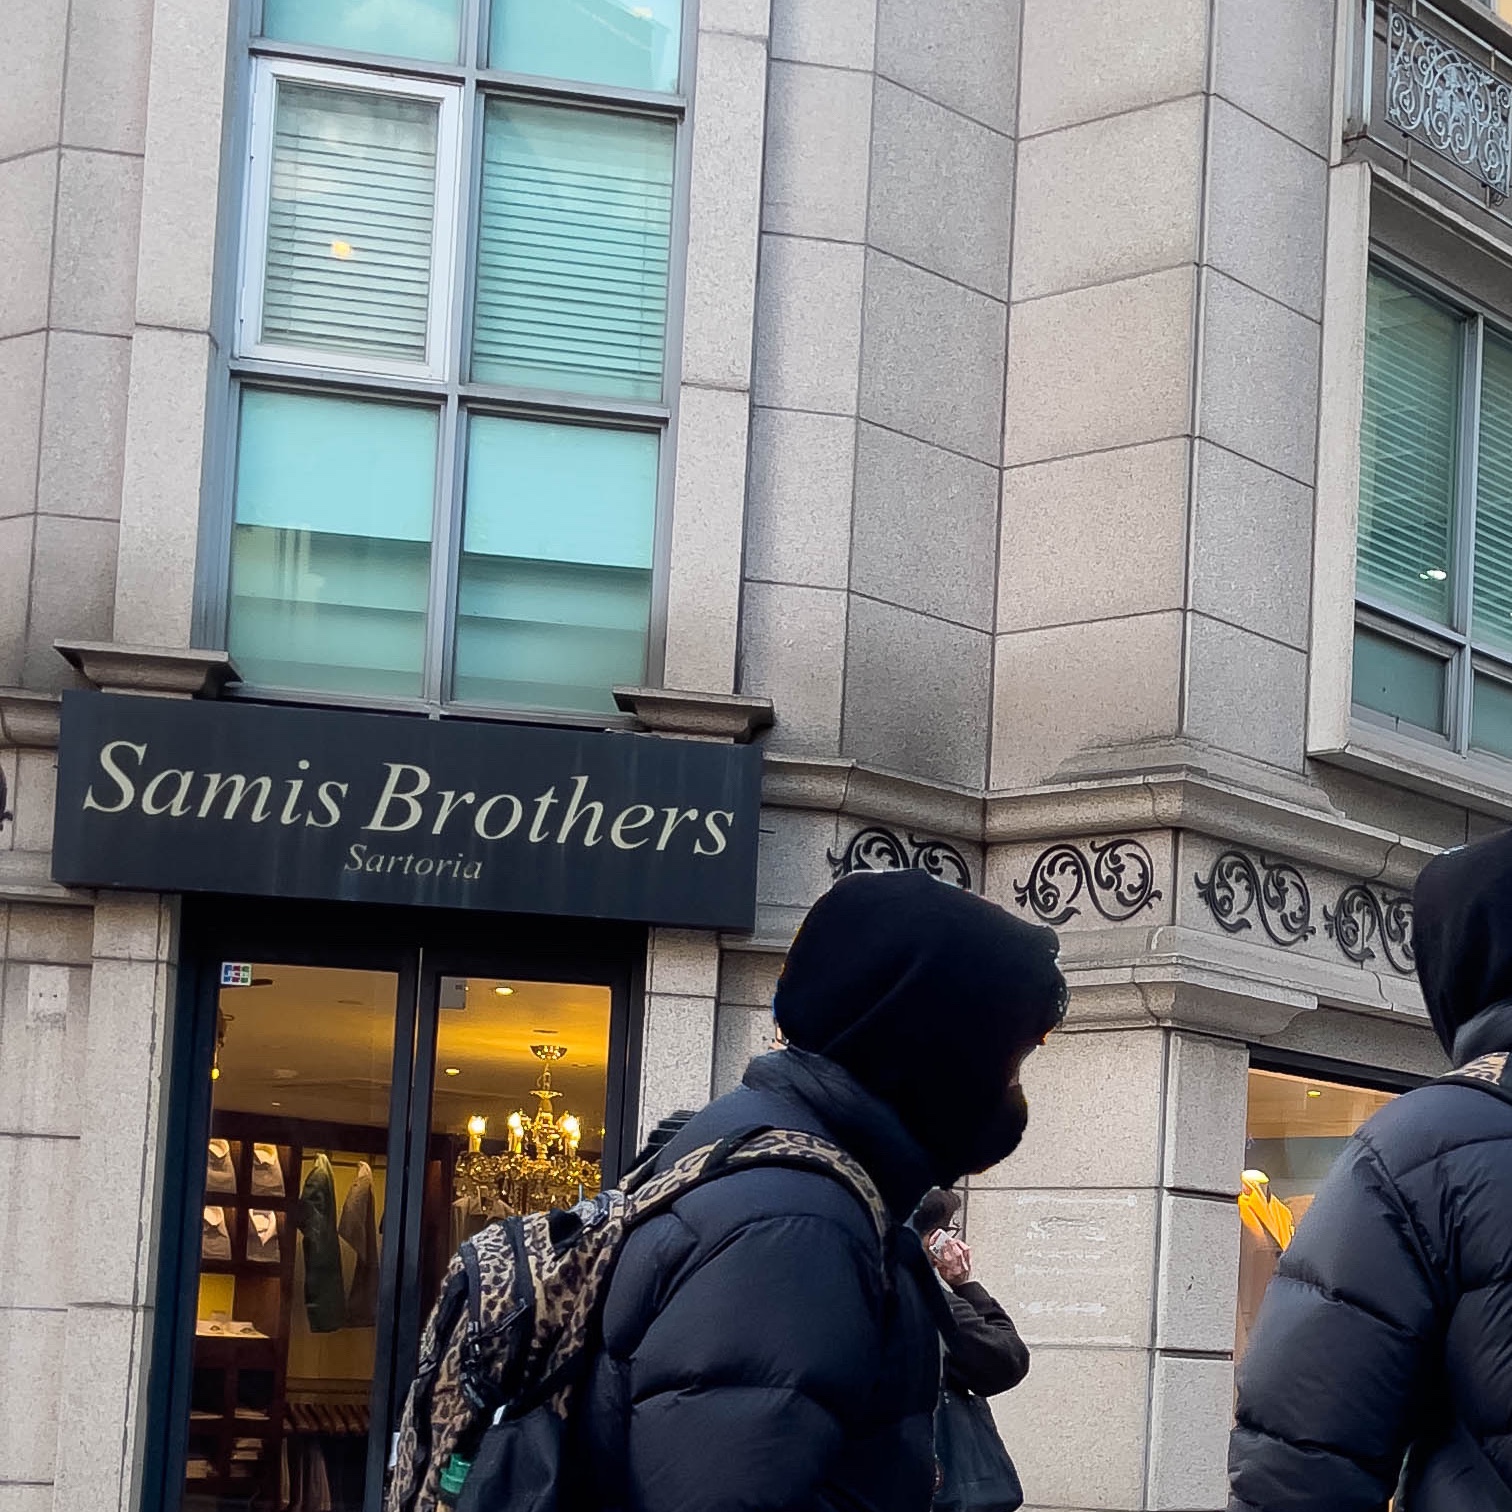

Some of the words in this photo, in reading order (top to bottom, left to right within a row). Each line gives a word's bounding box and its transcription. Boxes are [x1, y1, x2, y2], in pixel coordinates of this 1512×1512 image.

[83, 740, 349, 829] Samis
[365, 762, 735, 858] Brothers
[343, 842, 483, 881] Sartoria
